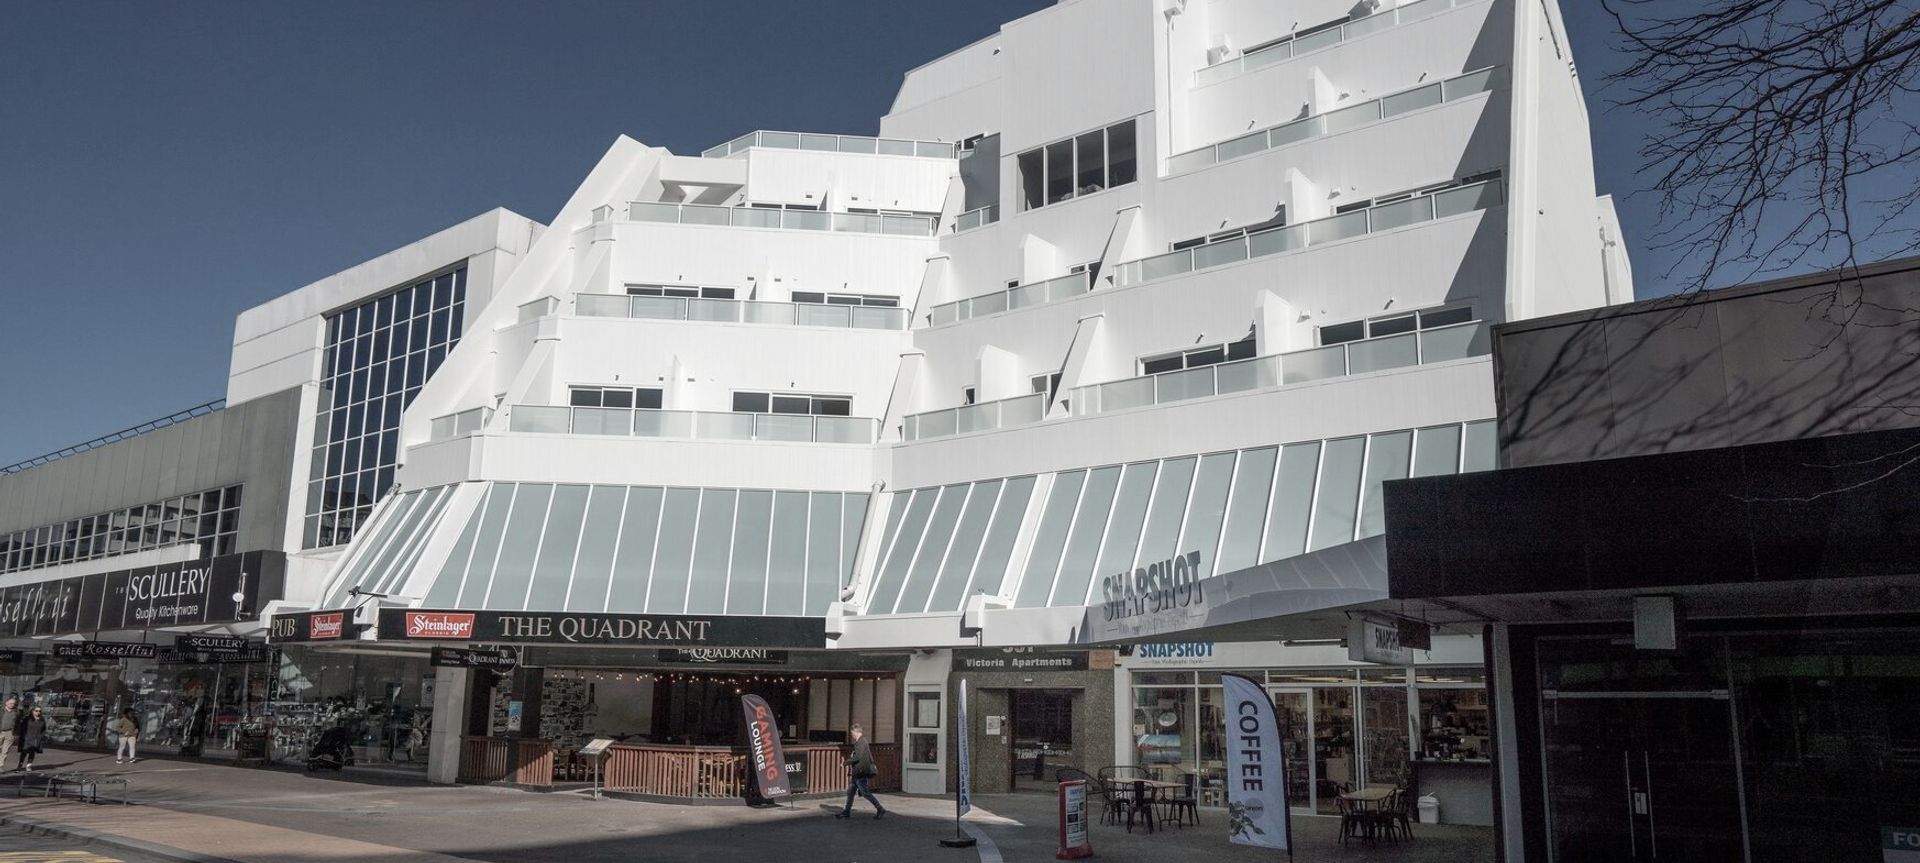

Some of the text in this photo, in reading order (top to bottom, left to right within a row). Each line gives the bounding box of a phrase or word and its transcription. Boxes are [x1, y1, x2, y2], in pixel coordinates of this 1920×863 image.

[129, 567, 210, 601] SCULLERY
[1102, 550, 1203, 622] SNAPSHOT
[0, 586, 70, 623] sellini
[271, 618, 296, 638] PUB
[410, 615, 470, 636] Steinlager
[498, 617, 712, 643] THE QUADRANT
[191, 638, 245, 648] SCULLERY
[691, 648, 767, 662] QUADRANT
[1140, 640, 1214, 657] SNAPSHOT
[966, 657, 1072, 668] Victoria Apartments
[751, 721, 765, 771] LOUNGE
[755, 706, 778, 781] GAMING
[1238, 700, 1264, 791] COFFEE
